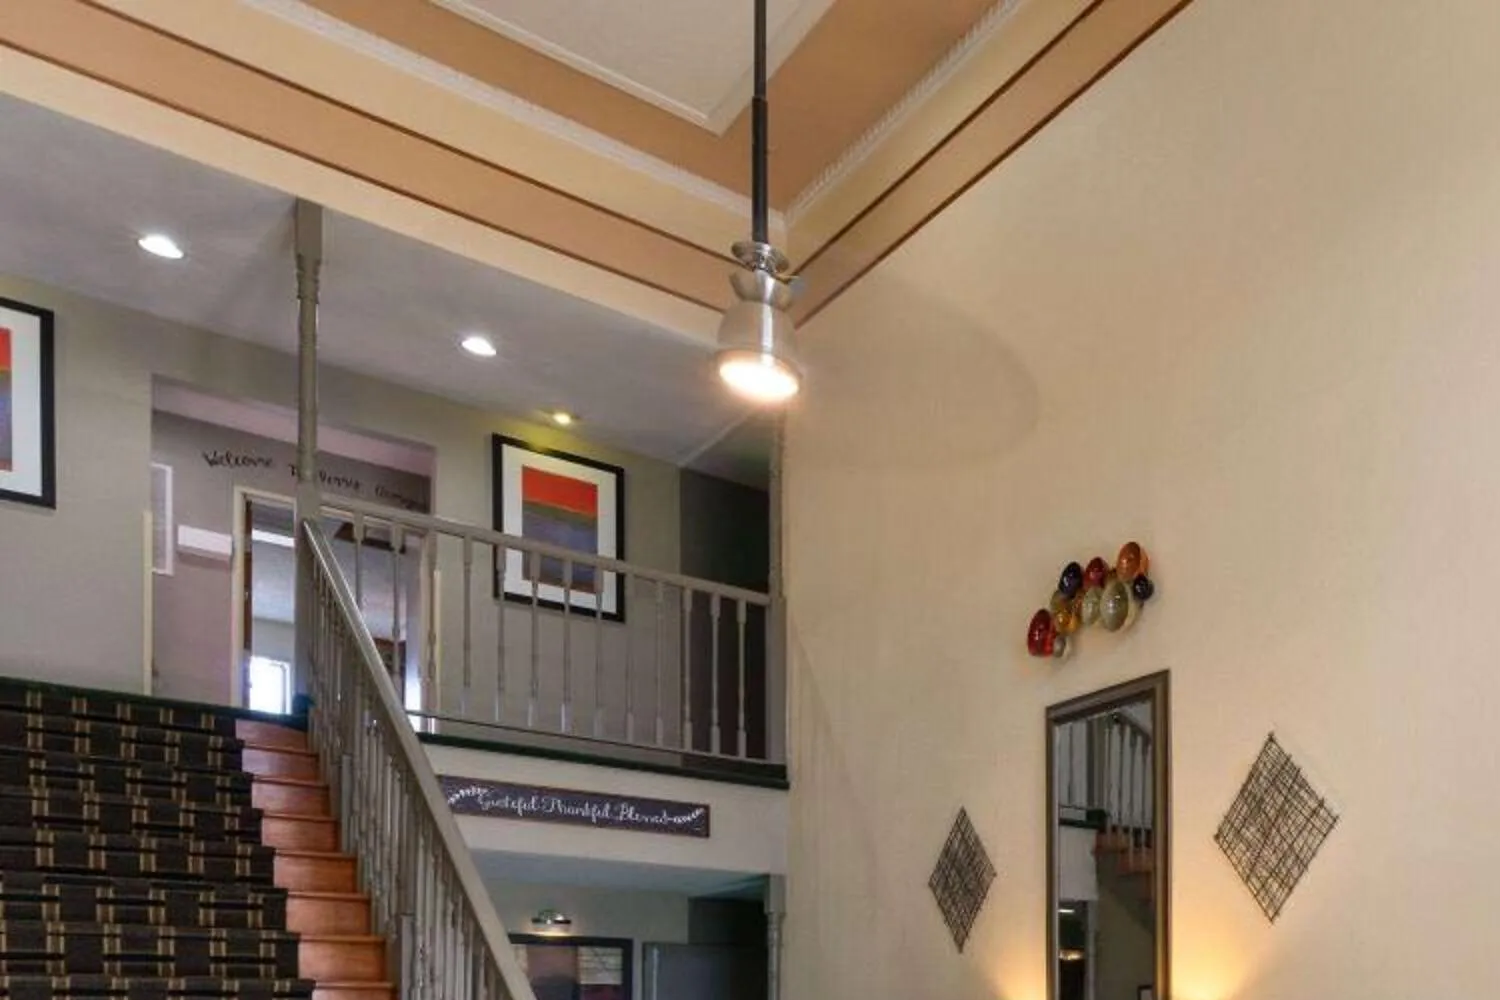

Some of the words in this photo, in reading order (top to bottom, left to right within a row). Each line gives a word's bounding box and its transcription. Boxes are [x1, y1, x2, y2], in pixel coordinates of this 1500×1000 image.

[203, 451, 273, 470] Welcome
[478, 795, 539, 816] Grateful
[543, 797, 611, 822] Thankful
